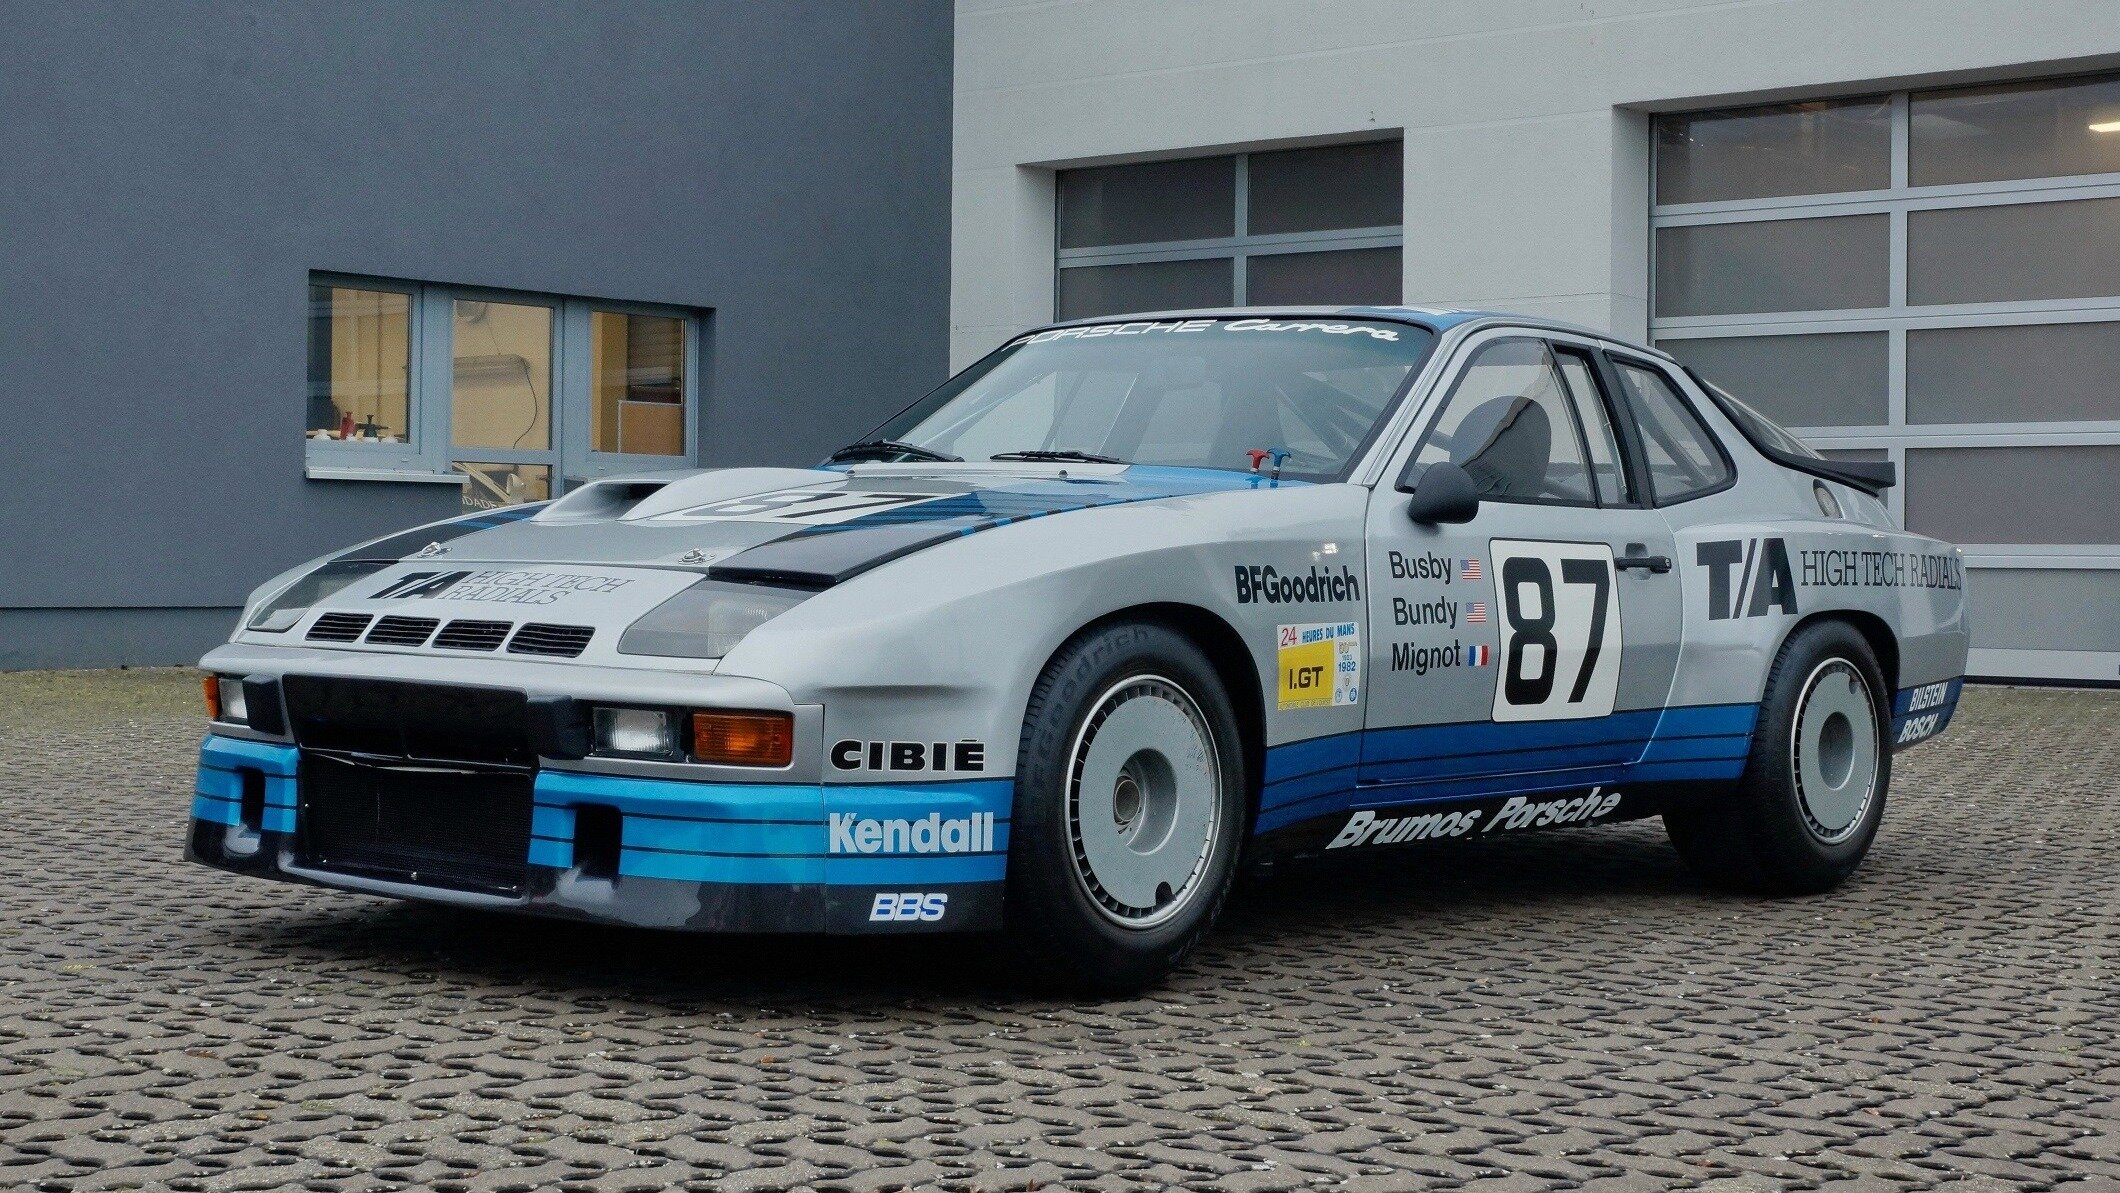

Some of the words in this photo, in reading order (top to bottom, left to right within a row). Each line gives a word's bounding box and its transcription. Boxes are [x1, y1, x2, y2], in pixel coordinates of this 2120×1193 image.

[999, 320, 1218, 352] PORSCHE
[1223, 318, 1400, 342] Carrera
[681, 492, 938, 519] 87
[462, 571, 546, 587] HIGH
[542, 573, 636, 593] TECH
[1388, 551, 1452, 585] Busby
[1696, 538, 1798, 620] T/A
[1800, 550, 1858, 587] HIGH
[1861, 551, 1906, 587] TECH
[1910, 553, 1962, 590] RADIALS
[438, 586, 570, 605] RADIALS
[1235, 565, 1360, 604] BFGoodrich
[1392, 596, 1457, 630] Bundy
[1281, 626, 1297, 646] 24
[1302, 628, 1323, 643] HEURES
[1325, 627, 1334, 639] DU
[1337, 623, 1355, 638] MANS
[1502, 556, 1611, 706] 87
[1338, 661, 1356, 672] 1982
[1391, 639, 1461, 676] Mignot
[1289, 666, 1323, 690] I.GT
[1909, 682, 1948, 711] BILSTEIN
[1897, 713, 1939, 743] BOSCH
[829, 811, 994, 853] Kendall
[1325, 809, 1482, 850] Brumos
[1481, 786, 1622, 833] Porsche
[869, 892, 948, 922] BBS
